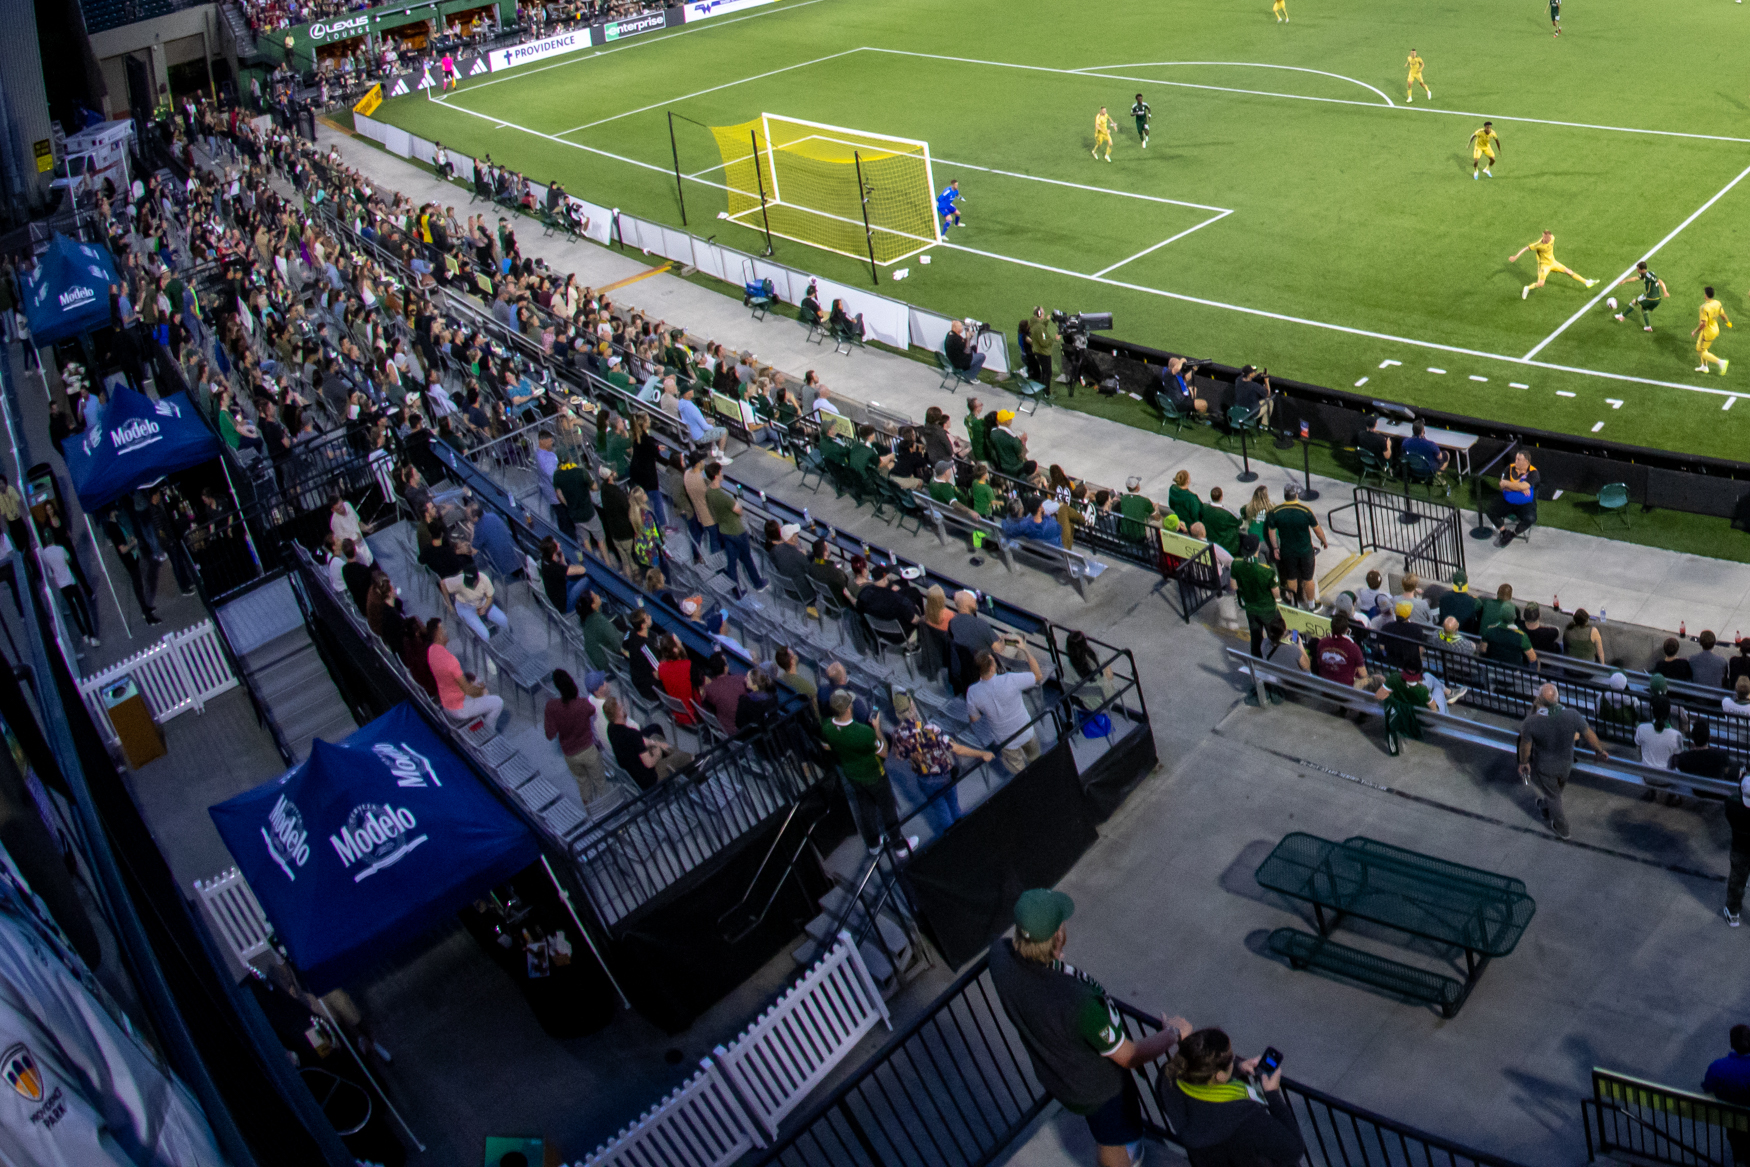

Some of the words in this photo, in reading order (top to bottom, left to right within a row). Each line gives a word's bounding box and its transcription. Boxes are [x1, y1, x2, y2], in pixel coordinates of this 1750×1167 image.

[326, 15, 369, 34] LEXUS
[326, 25, 370, 41] LOUNGE
[607, 15, 664, 37] enterprise
[514, 35, 576, 59] PROVIDENCE
[58, 287, 95, 307] Modelo
[110, 419, 161, 448] Modelo
[269, 793, 309, 867] Modelo
[330, 803, 396, 868] Modelo
[43, 1103, 67, 1131] PARK
